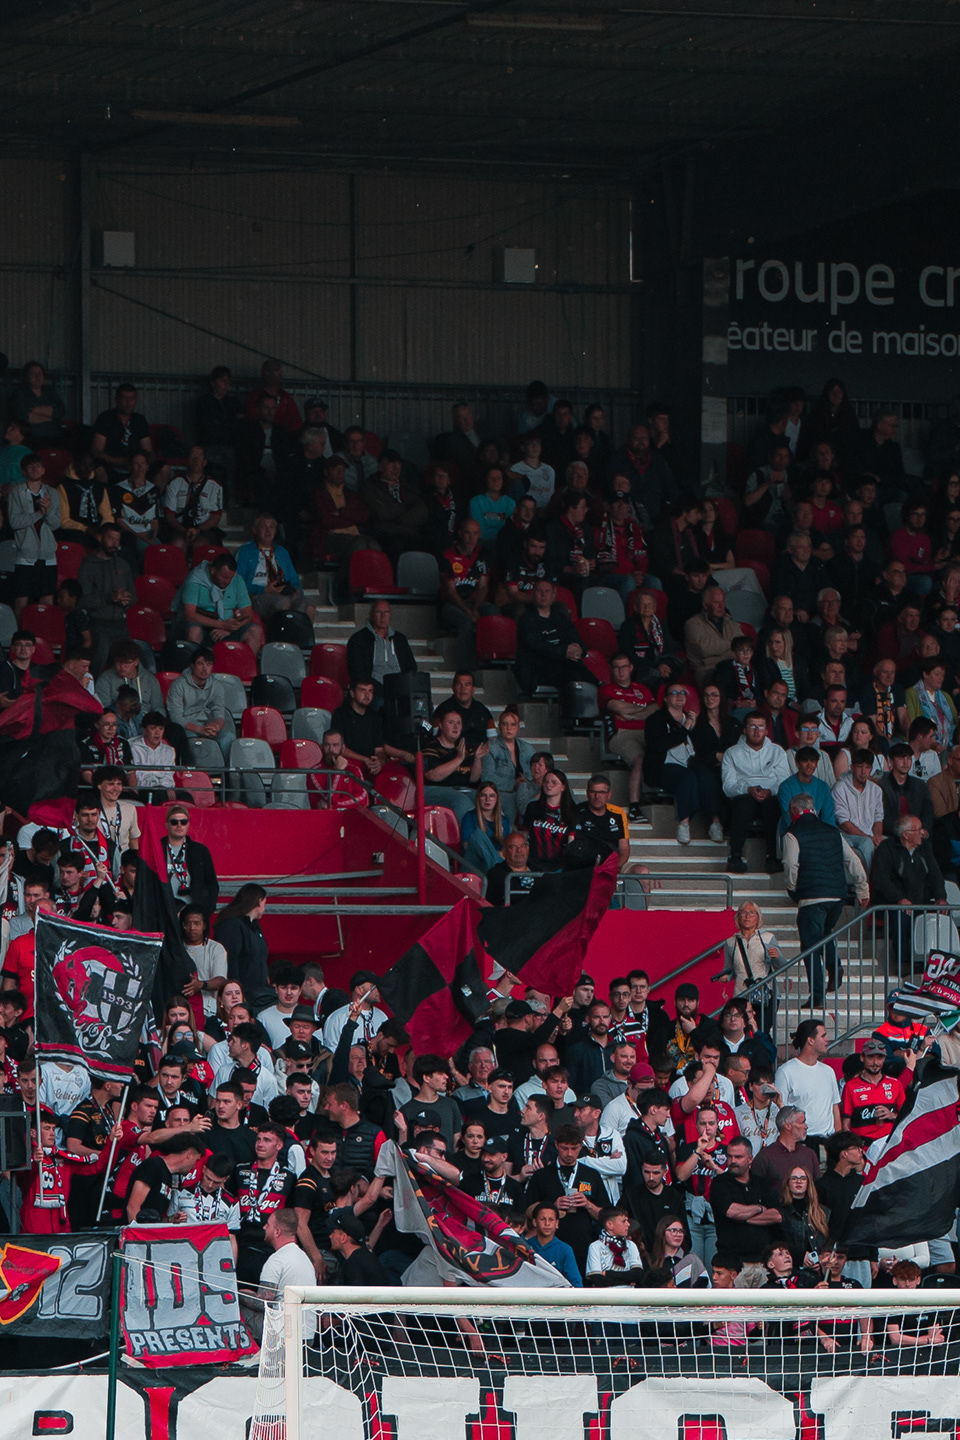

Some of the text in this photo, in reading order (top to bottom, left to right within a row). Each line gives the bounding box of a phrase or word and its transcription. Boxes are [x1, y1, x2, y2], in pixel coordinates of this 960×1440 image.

[736, 259, 960, 316] roupe cr
[828, 321, 863, 353] de
[872, 325, 960, 357] maiso
[101, 988, 133, 1010] 1993
[130, 1323, 249, 1357] PRESENTS
